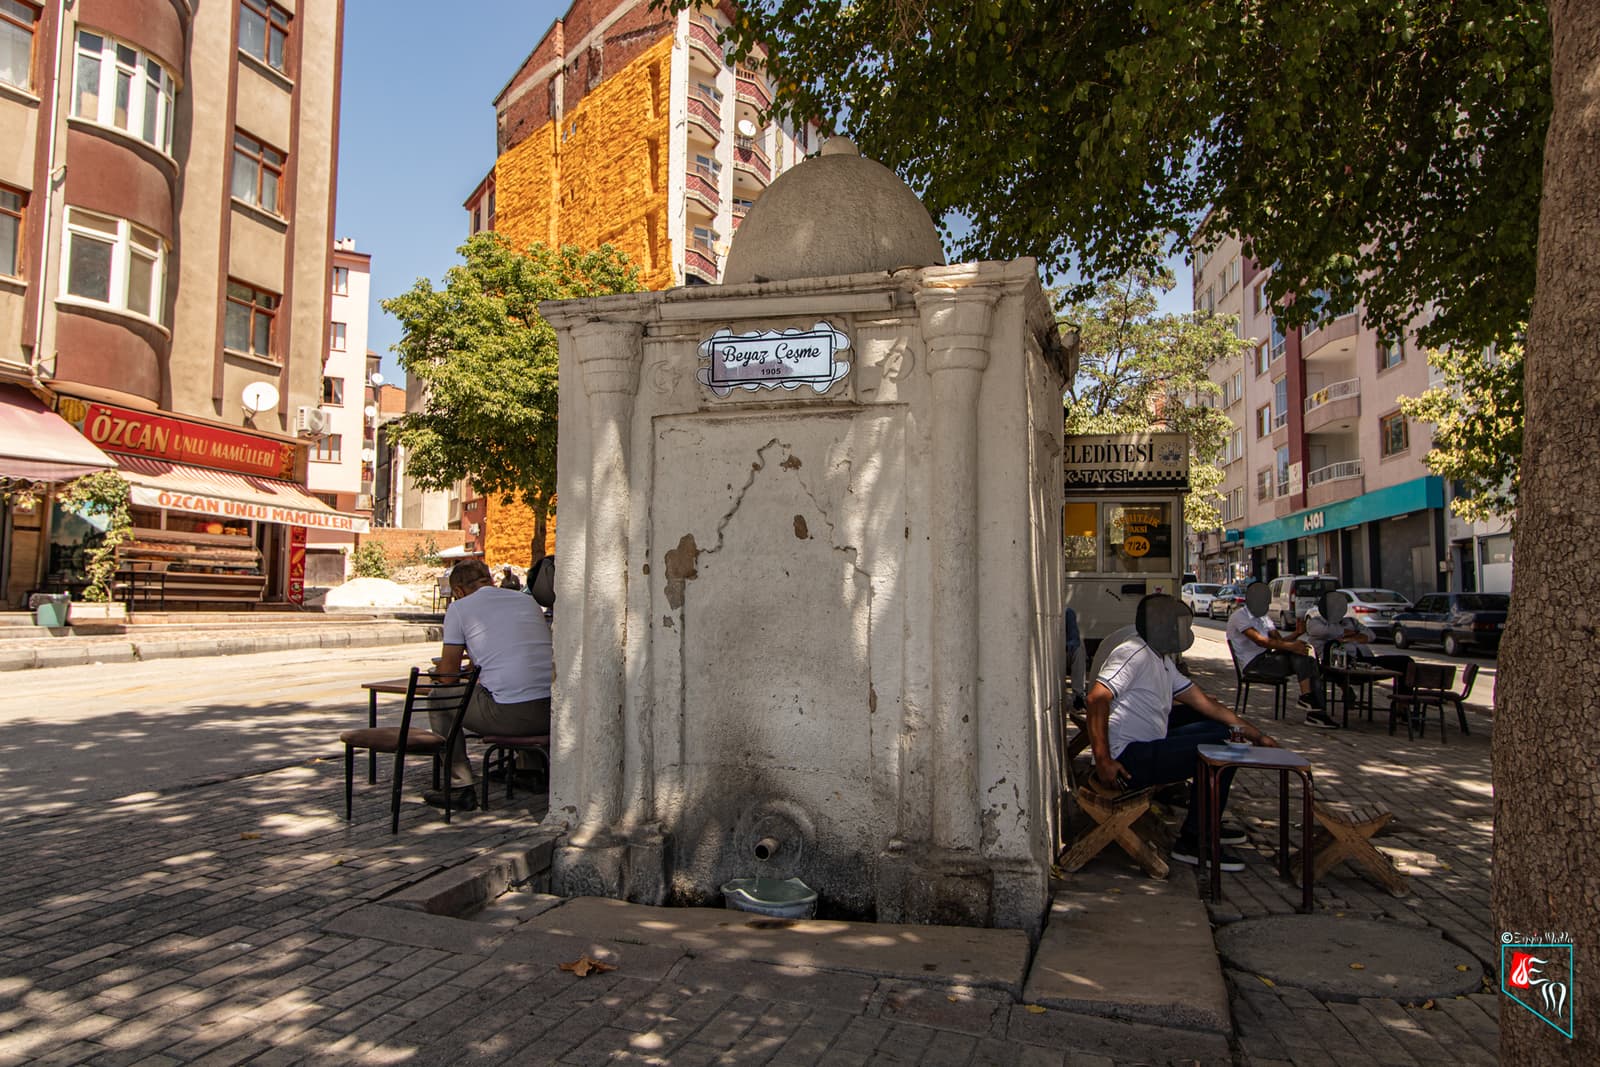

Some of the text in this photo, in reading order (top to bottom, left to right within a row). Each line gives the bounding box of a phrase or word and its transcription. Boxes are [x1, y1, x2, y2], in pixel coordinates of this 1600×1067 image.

[721, 342, 821, 367] Beyaz Çeşme
[91, 408, 276, 468] ÖZCAN UNLU MAMÜLLERİ
[1127, 541, 1147, 551] 7/24
